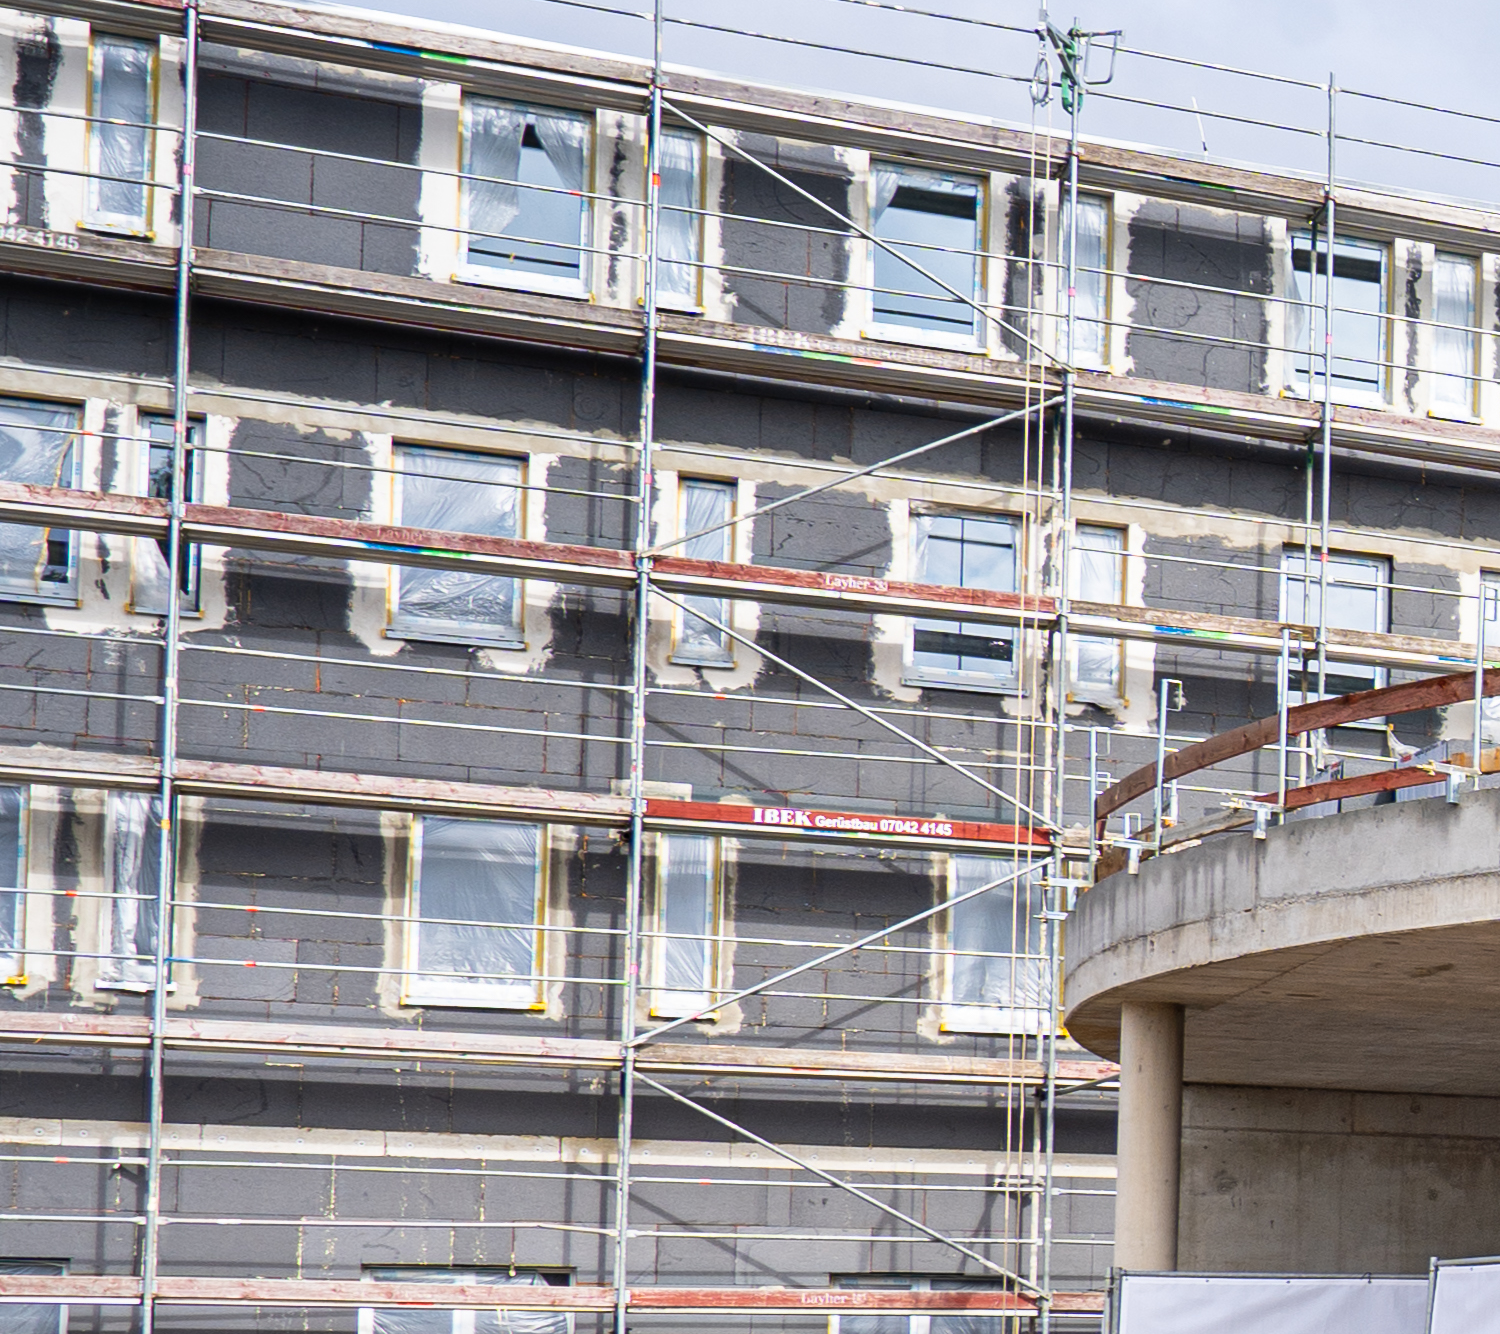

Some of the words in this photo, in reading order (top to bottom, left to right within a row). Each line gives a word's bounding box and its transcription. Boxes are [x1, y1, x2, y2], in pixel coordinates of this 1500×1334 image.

[33, 230, 79, 250] 4145
[825, 574, 871, 591] Layher
[752, 807, 813, 827] IBEK
[814, 815, 878, 831] Gerüstbau
[879, 819, 919, 835] 07042
[919, 821, 953, 837] 4145
[801, 1292, 848, 1306] Layher
